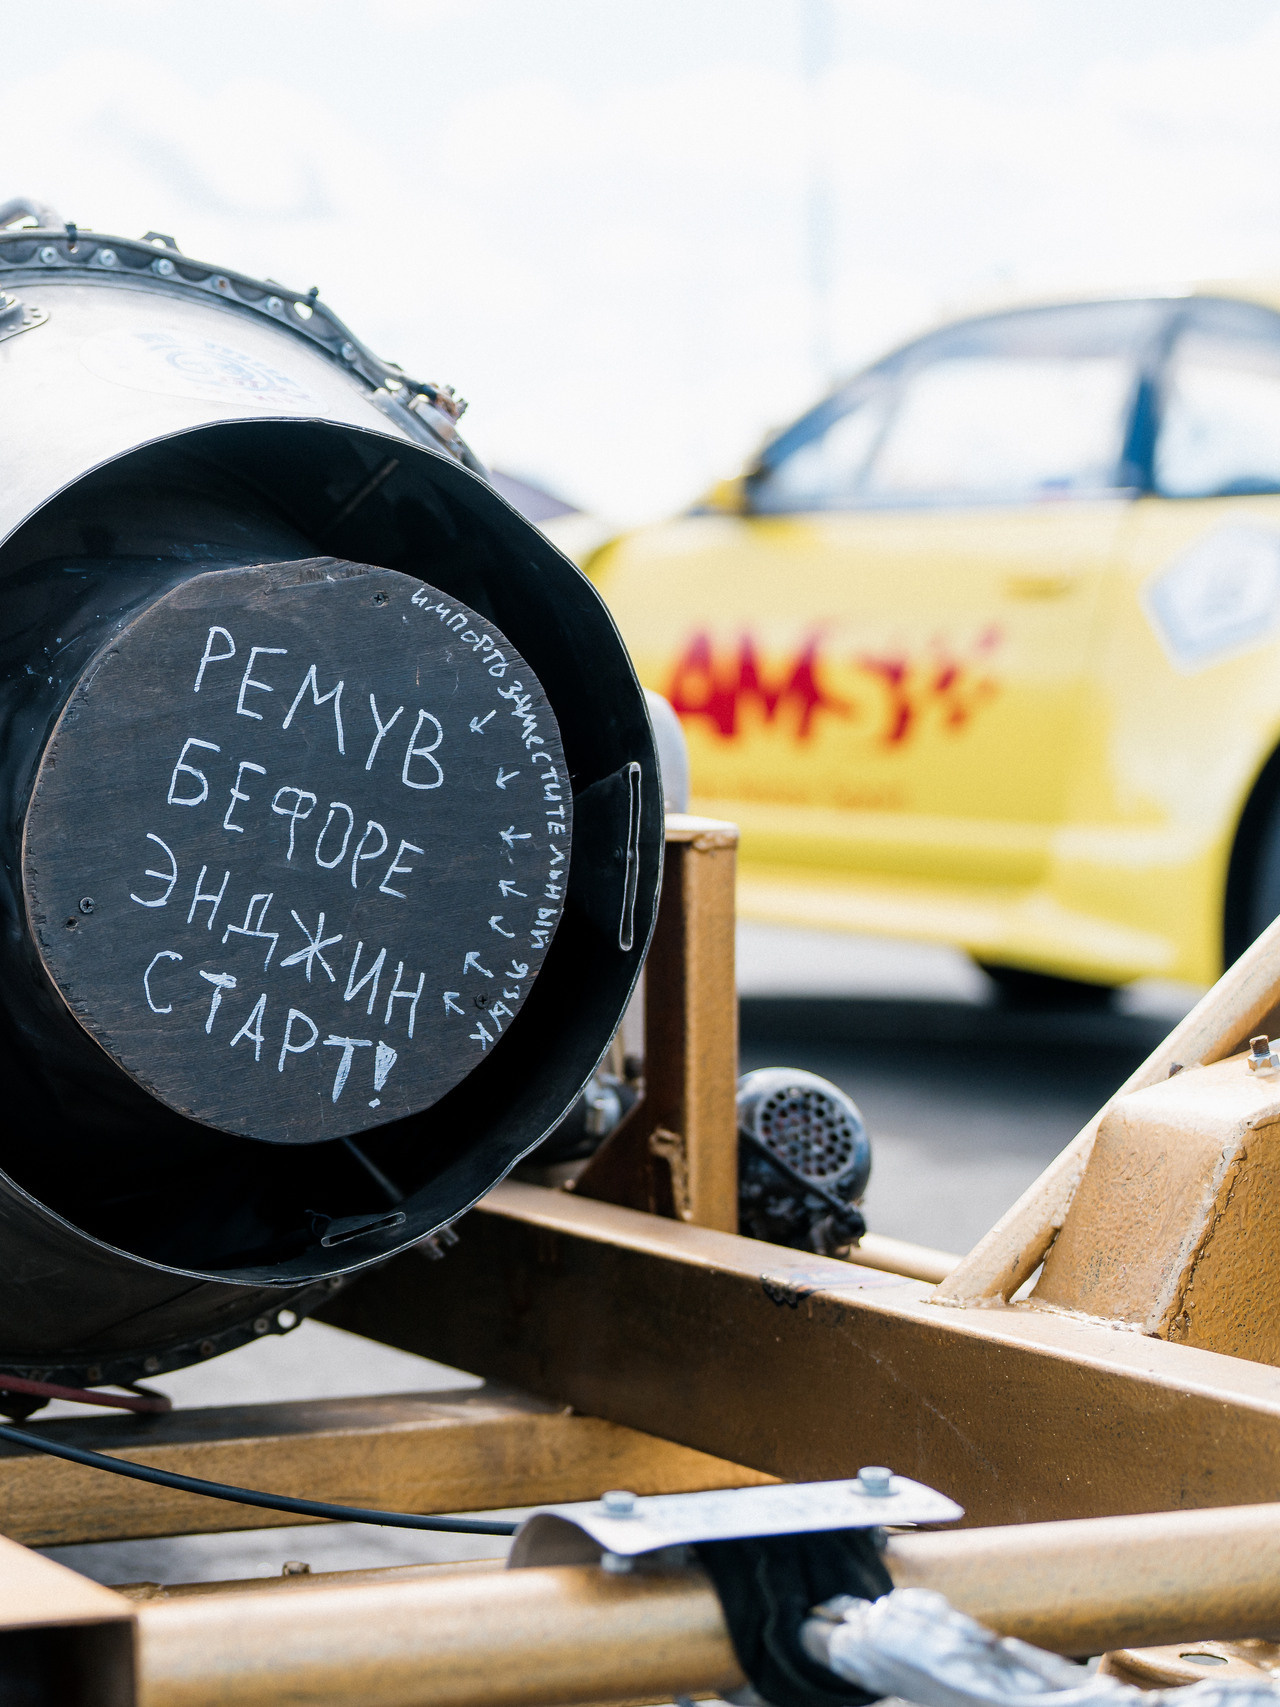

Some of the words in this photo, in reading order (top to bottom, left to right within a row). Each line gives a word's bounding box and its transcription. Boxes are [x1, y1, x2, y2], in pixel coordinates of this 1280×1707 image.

[193, 625, 444, 789] РЕМУВ
[167, 737, 425, 899] БЕФОРЕ
[129, 832, 426, 1039] ЭНДЖИН
[142, 950, 398, 1108] СТАРТ!
